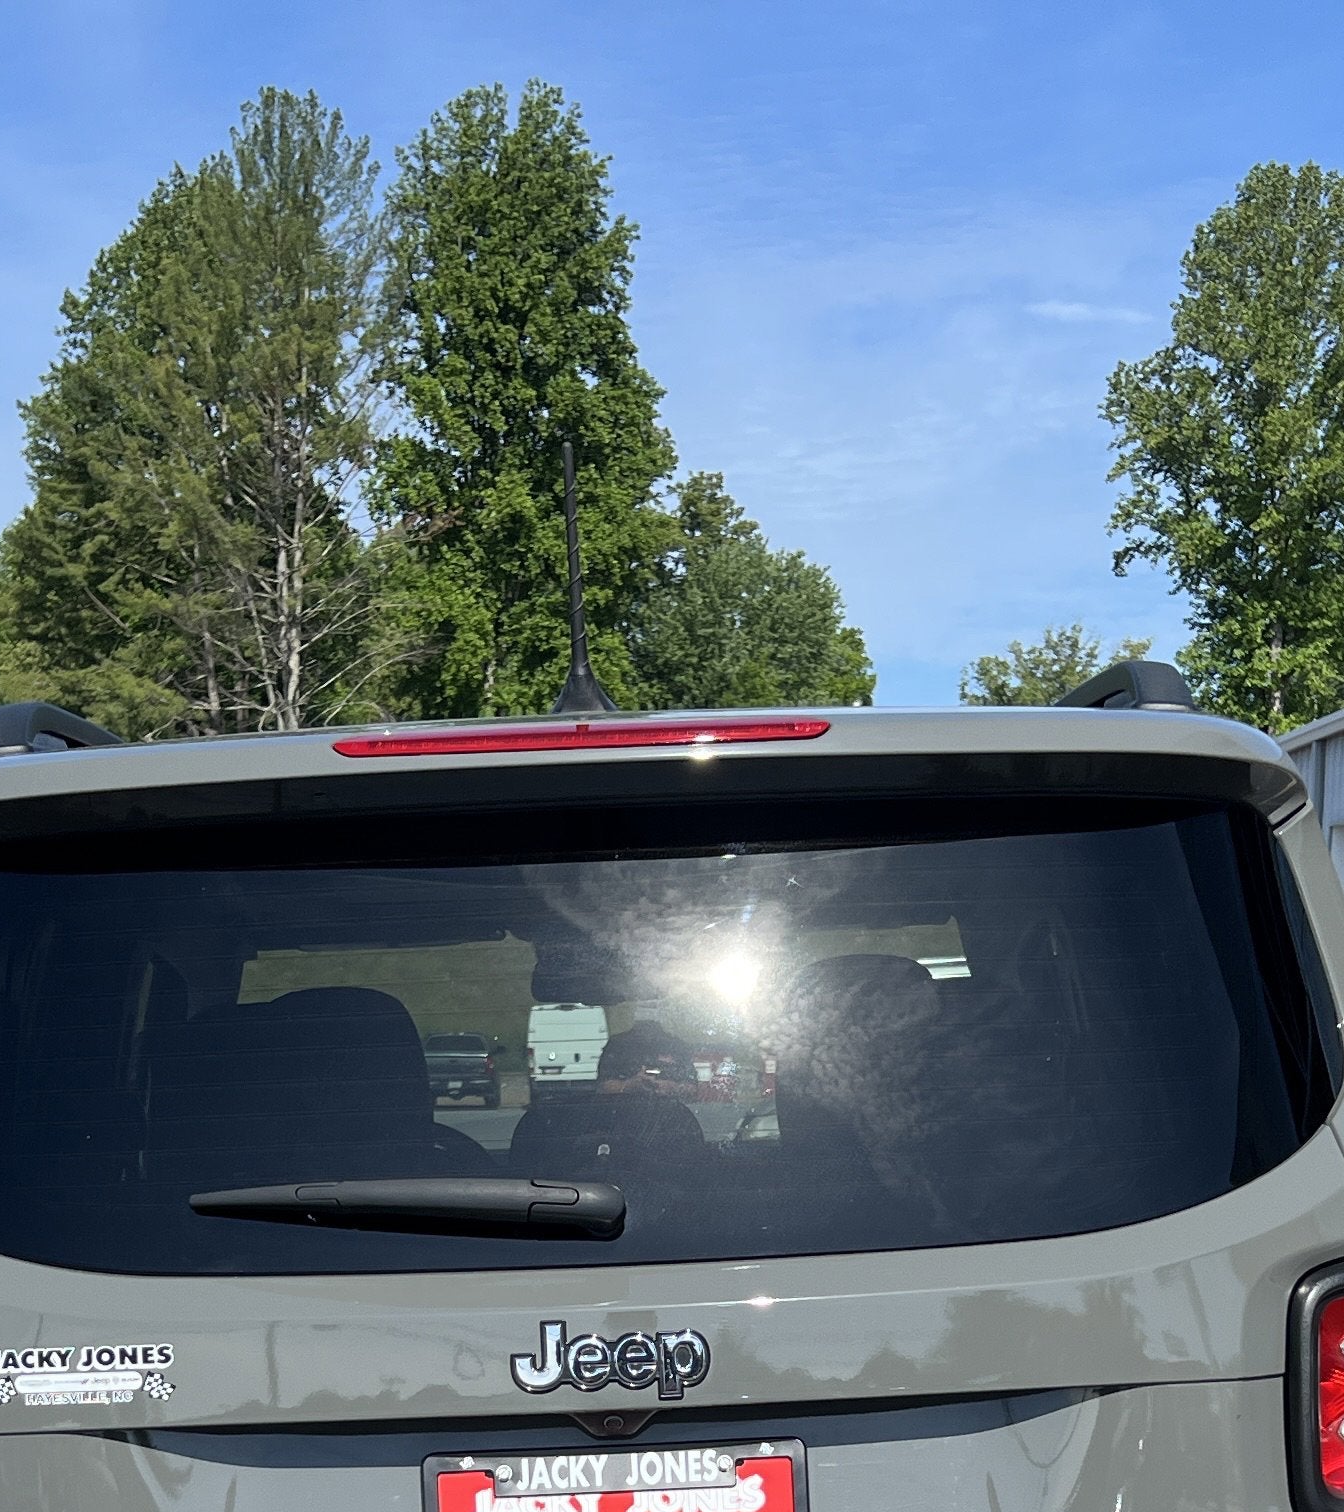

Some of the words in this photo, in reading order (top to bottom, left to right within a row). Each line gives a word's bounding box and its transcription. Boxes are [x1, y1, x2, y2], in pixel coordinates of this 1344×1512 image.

[77, 1344, 174, 1371] JONES
[510, 1319, 711, 1401] Jeep
[515, 1454, 609, 1491] JACKY
[625, 1449, 719, 1486] JONES
